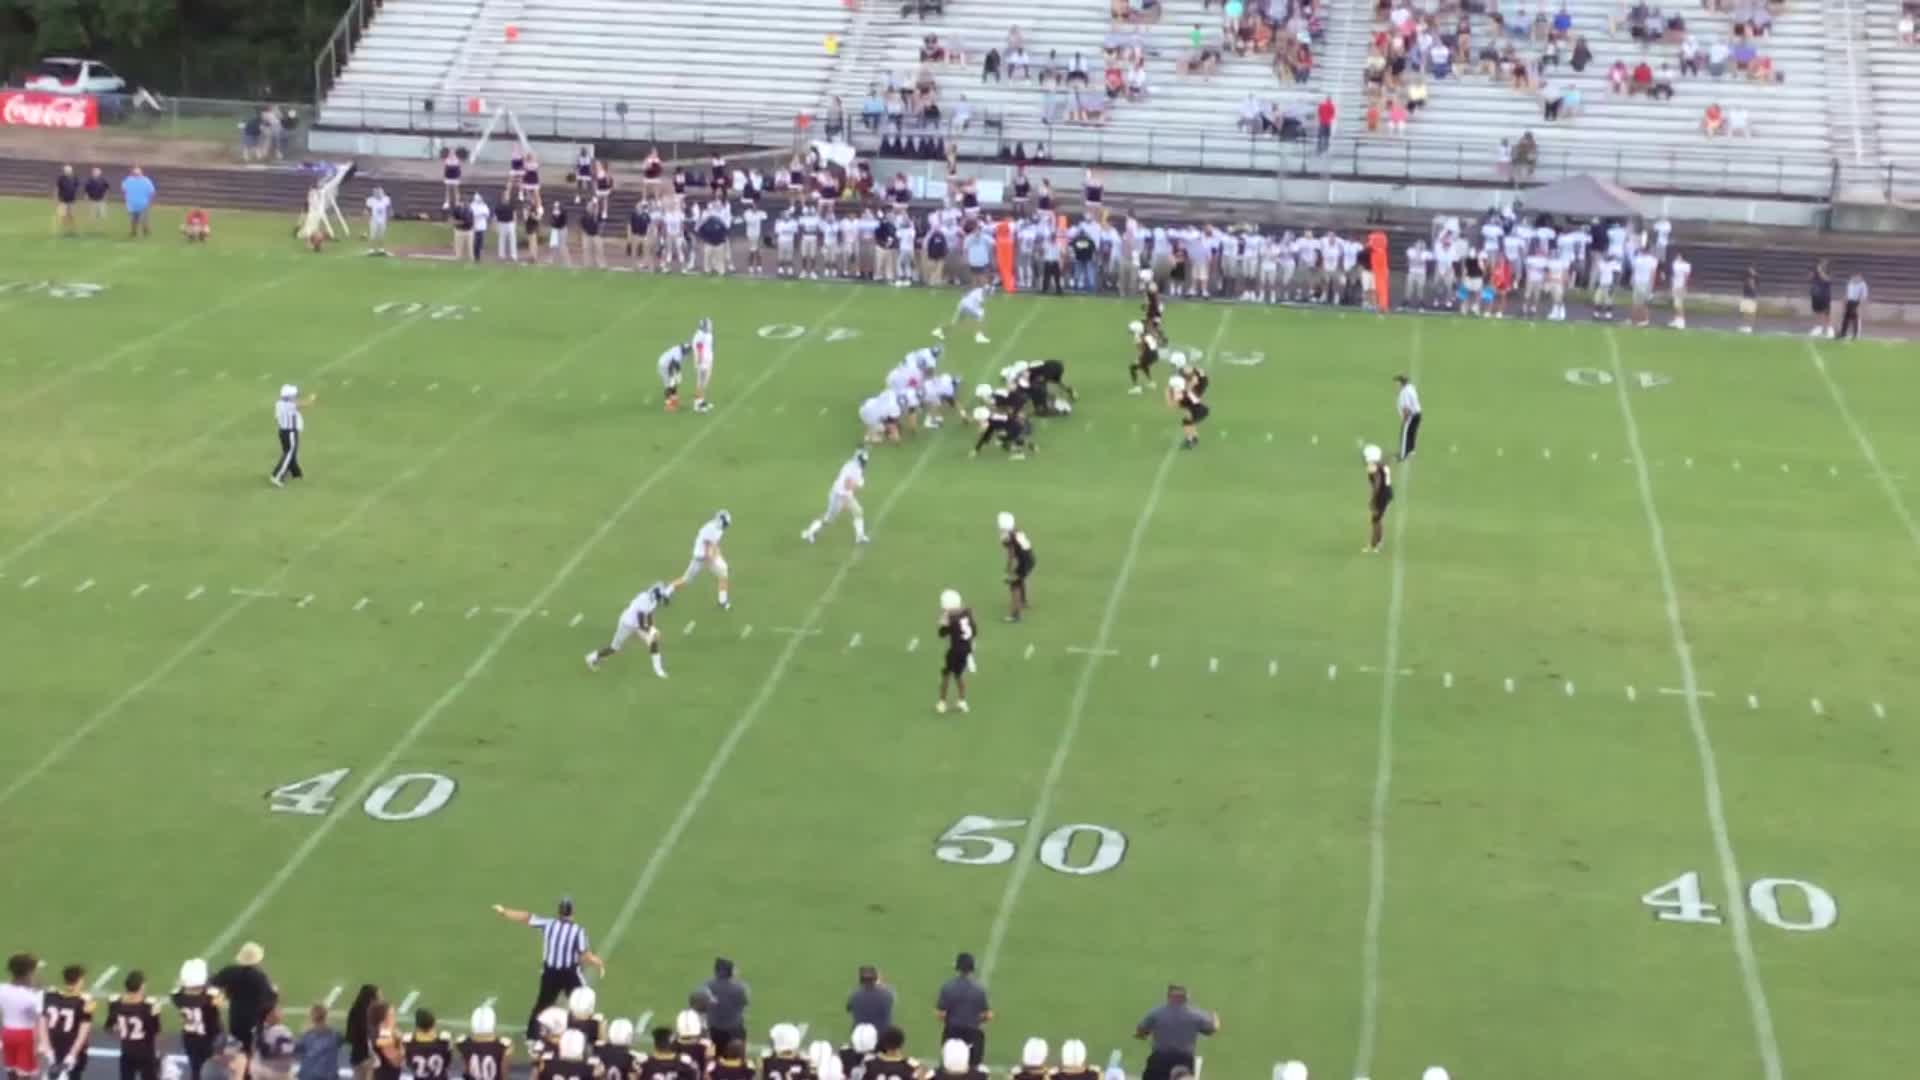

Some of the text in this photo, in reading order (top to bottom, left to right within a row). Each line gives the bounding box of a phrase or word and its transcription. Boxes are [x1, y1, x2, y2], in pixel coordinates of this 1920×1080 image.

[269, 766, 457, 821] 40
[934, 814, 1127, 876] 50
[1640, 870, 1838, 932] 40
[411, 1053, 445, 1079] 29
